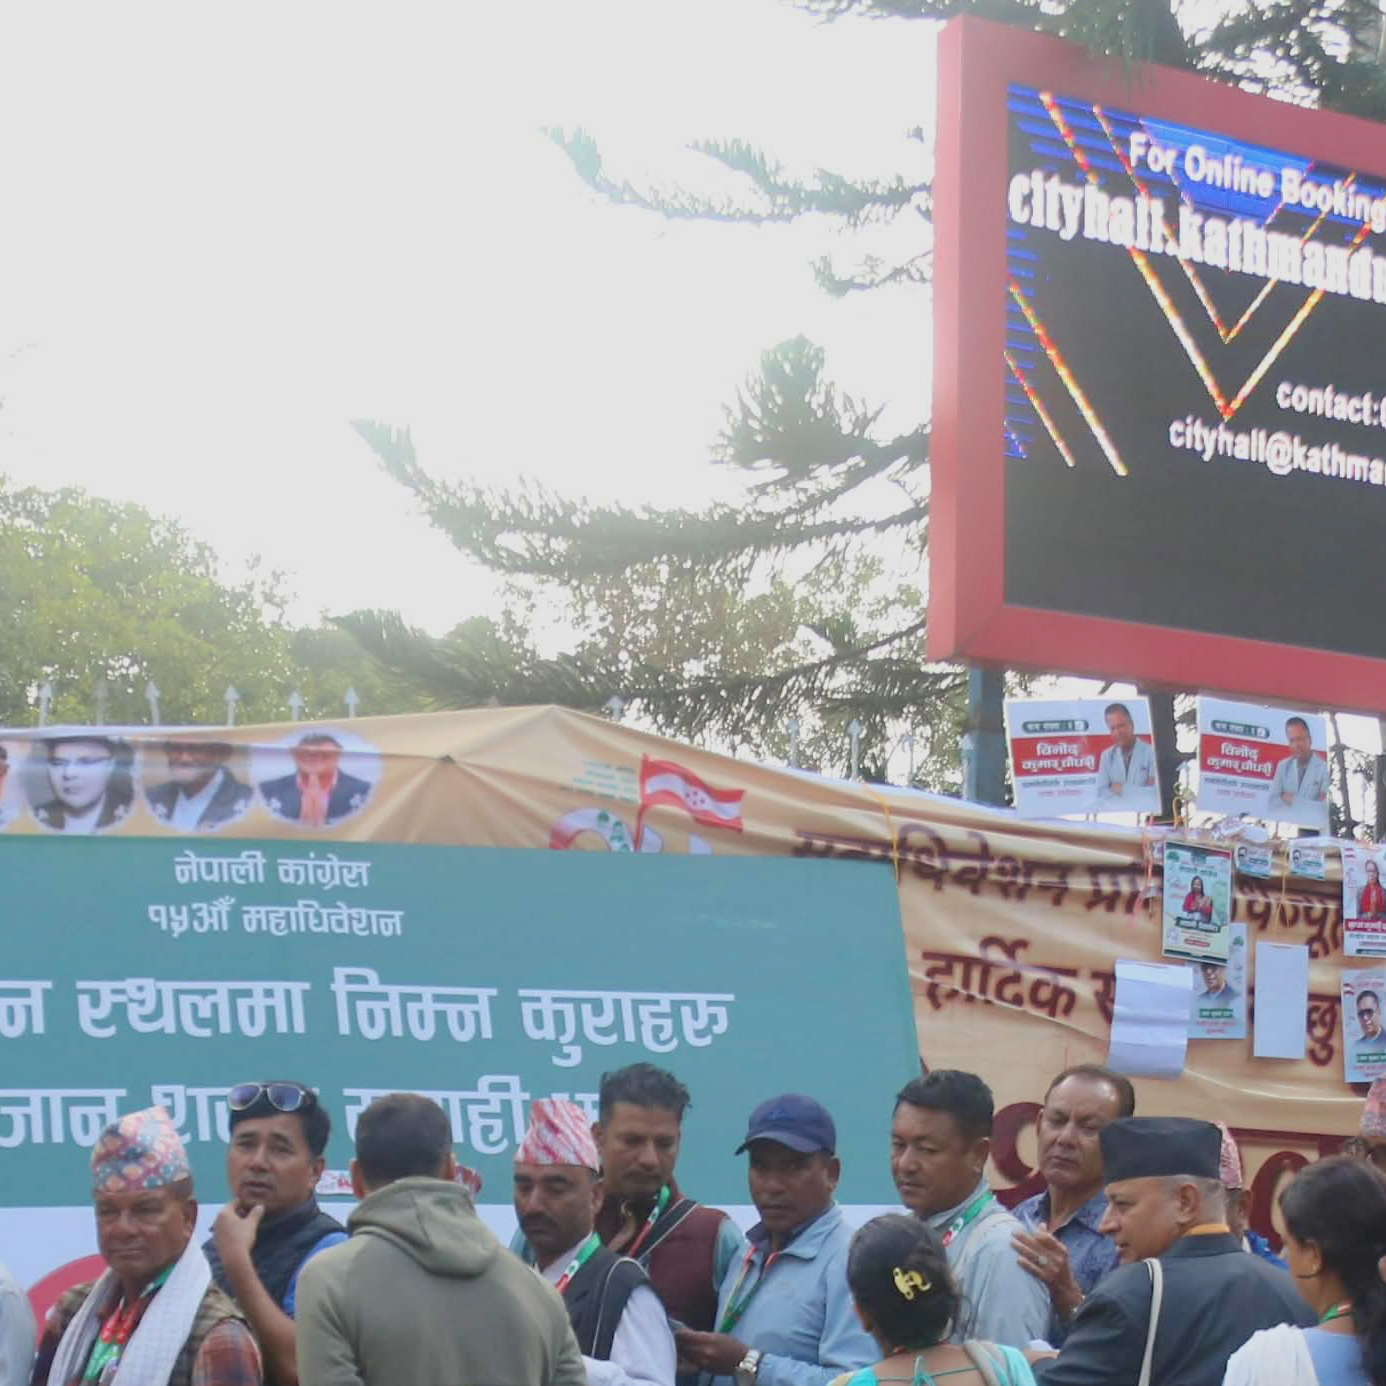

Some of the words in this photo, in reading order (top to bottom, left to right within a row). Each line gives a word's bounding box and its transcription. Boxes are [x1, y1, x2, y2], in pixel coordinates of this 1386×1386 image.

[1129, 132, 1178, 176] For
[1184, 145, 1273, 198] Online
[174, 850, 266, 884] नेपाली
[277, 851, 372, 890] कांग्रेस
[242, 899, 405, 937] महाधिवेशन
[75, 977, 310, 1038] स्थलमा
[330, 966, 498, 1043] निम्न
[922, 936, 1079, 1018] हार्दिक
